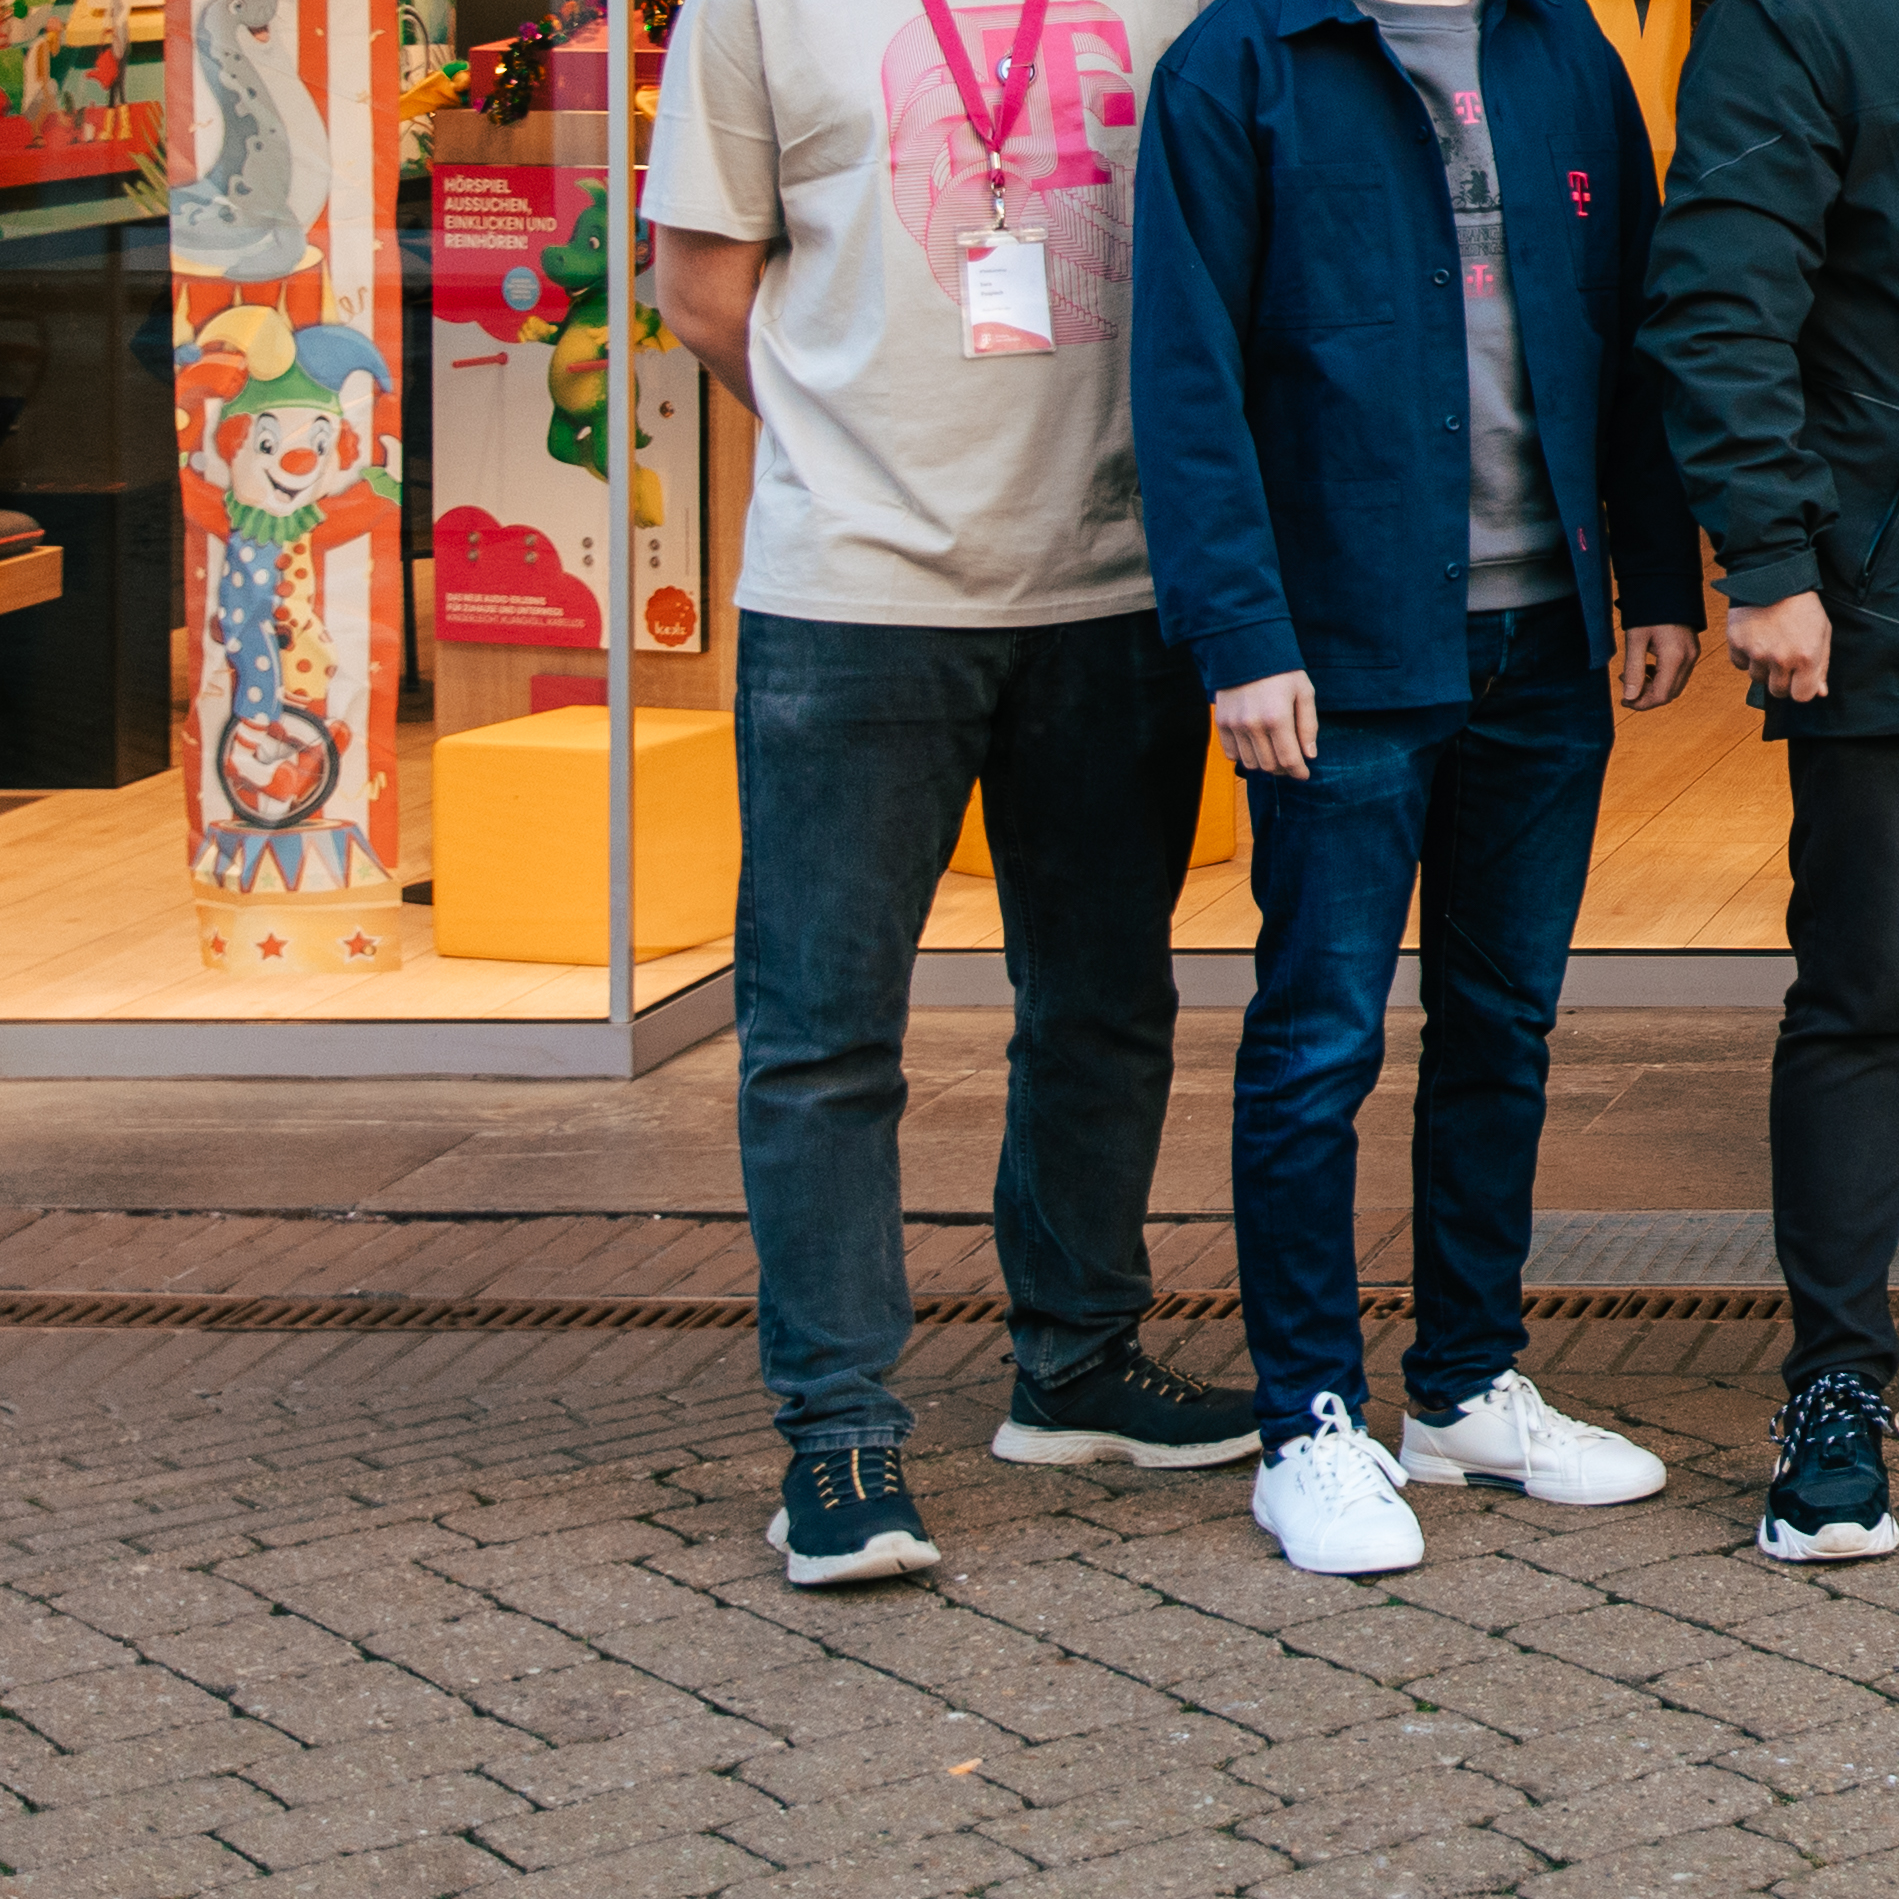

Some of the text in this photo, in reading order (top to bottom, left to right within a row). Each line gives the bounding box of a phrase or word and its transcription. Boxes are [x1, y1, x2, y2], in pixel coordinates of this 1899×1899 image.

[1454, 91, 1482, 126] T
[444, 175, 512, 193] HÖRSPIEL
[1567, 170, 1592, 218] T
[444, 197, 533, 215] AUSSUCHEN,
[444, 215, 558, 232] EINKLICKEN UND
[444, 232, 528, 249] REINHÖREN!
